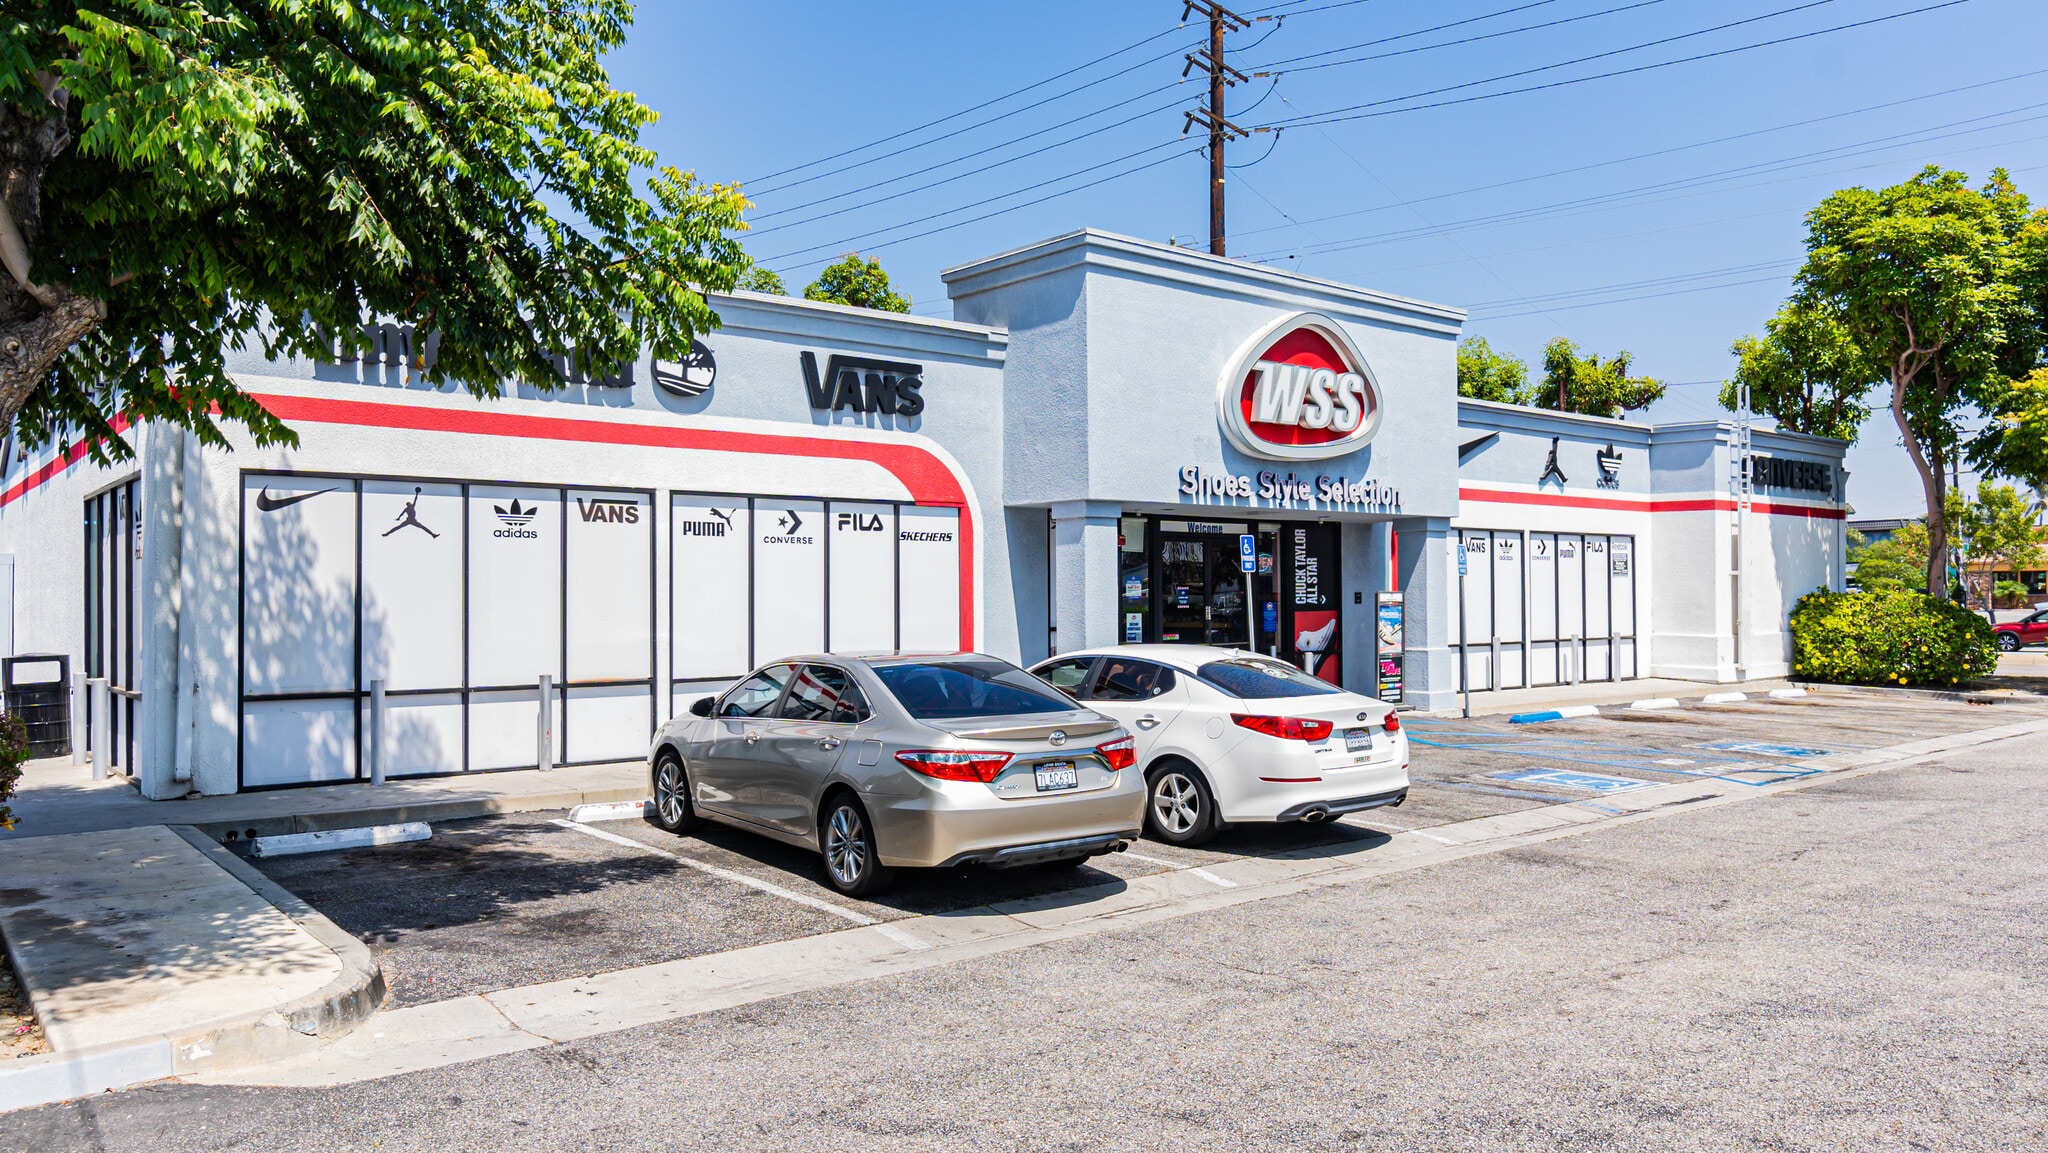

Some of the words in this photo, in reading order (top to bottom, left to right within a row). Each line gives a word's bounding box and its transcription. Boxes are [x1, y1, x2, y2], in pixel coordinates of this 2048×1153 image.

[800, 351, 925, 416] VANS
[1250, 359, 1365, 432] WSS
[576, 497, 640, 524] VANS
[683, 520, 726, 537] PUMA
[838, 513, 884, 532] FILA
[1187, 521, 1223, 534] Welcome
[493, 527, 538, 539] adidas
[763, 536, 814, 545] CONVERSE
[899, 531, 953, 542] SKECHERS
[1295, 529, 1306, 567] TAYLOR
[1465, 537, 1486, 553] VANS
[1586, 541, 1604, 552] FILA
[1306, 557, 1318, 584] STAR
[1295, 569, 1307, 605] CHUCK
[1306, 586, 1318, 605] ALL
[1037, 771, 1074, 787] 7LAC637
